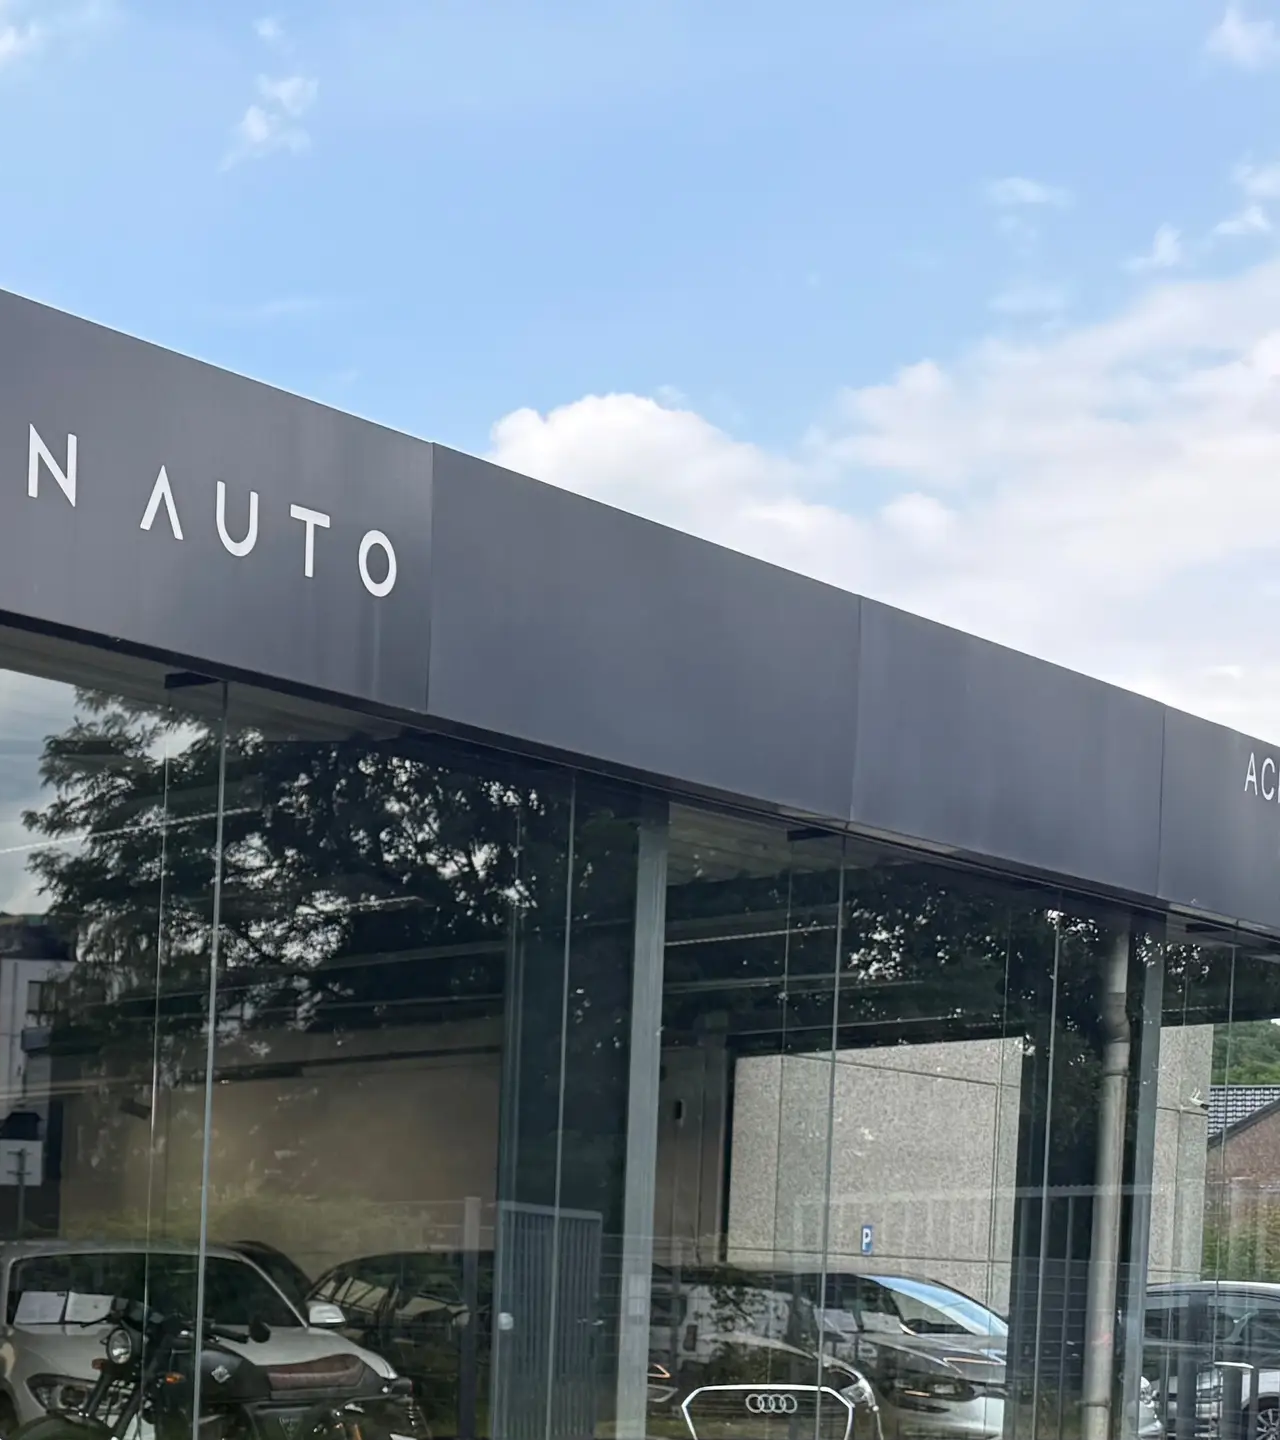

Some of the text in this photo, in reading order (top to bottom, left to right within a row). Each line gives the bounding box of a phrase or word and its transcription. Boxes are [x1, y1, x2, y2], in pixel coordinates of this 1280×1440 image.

[139, 464, 399, 598] AUTO
[1244, 752, 1280, 804] AC
[862, 1227, 872, 1251] P
